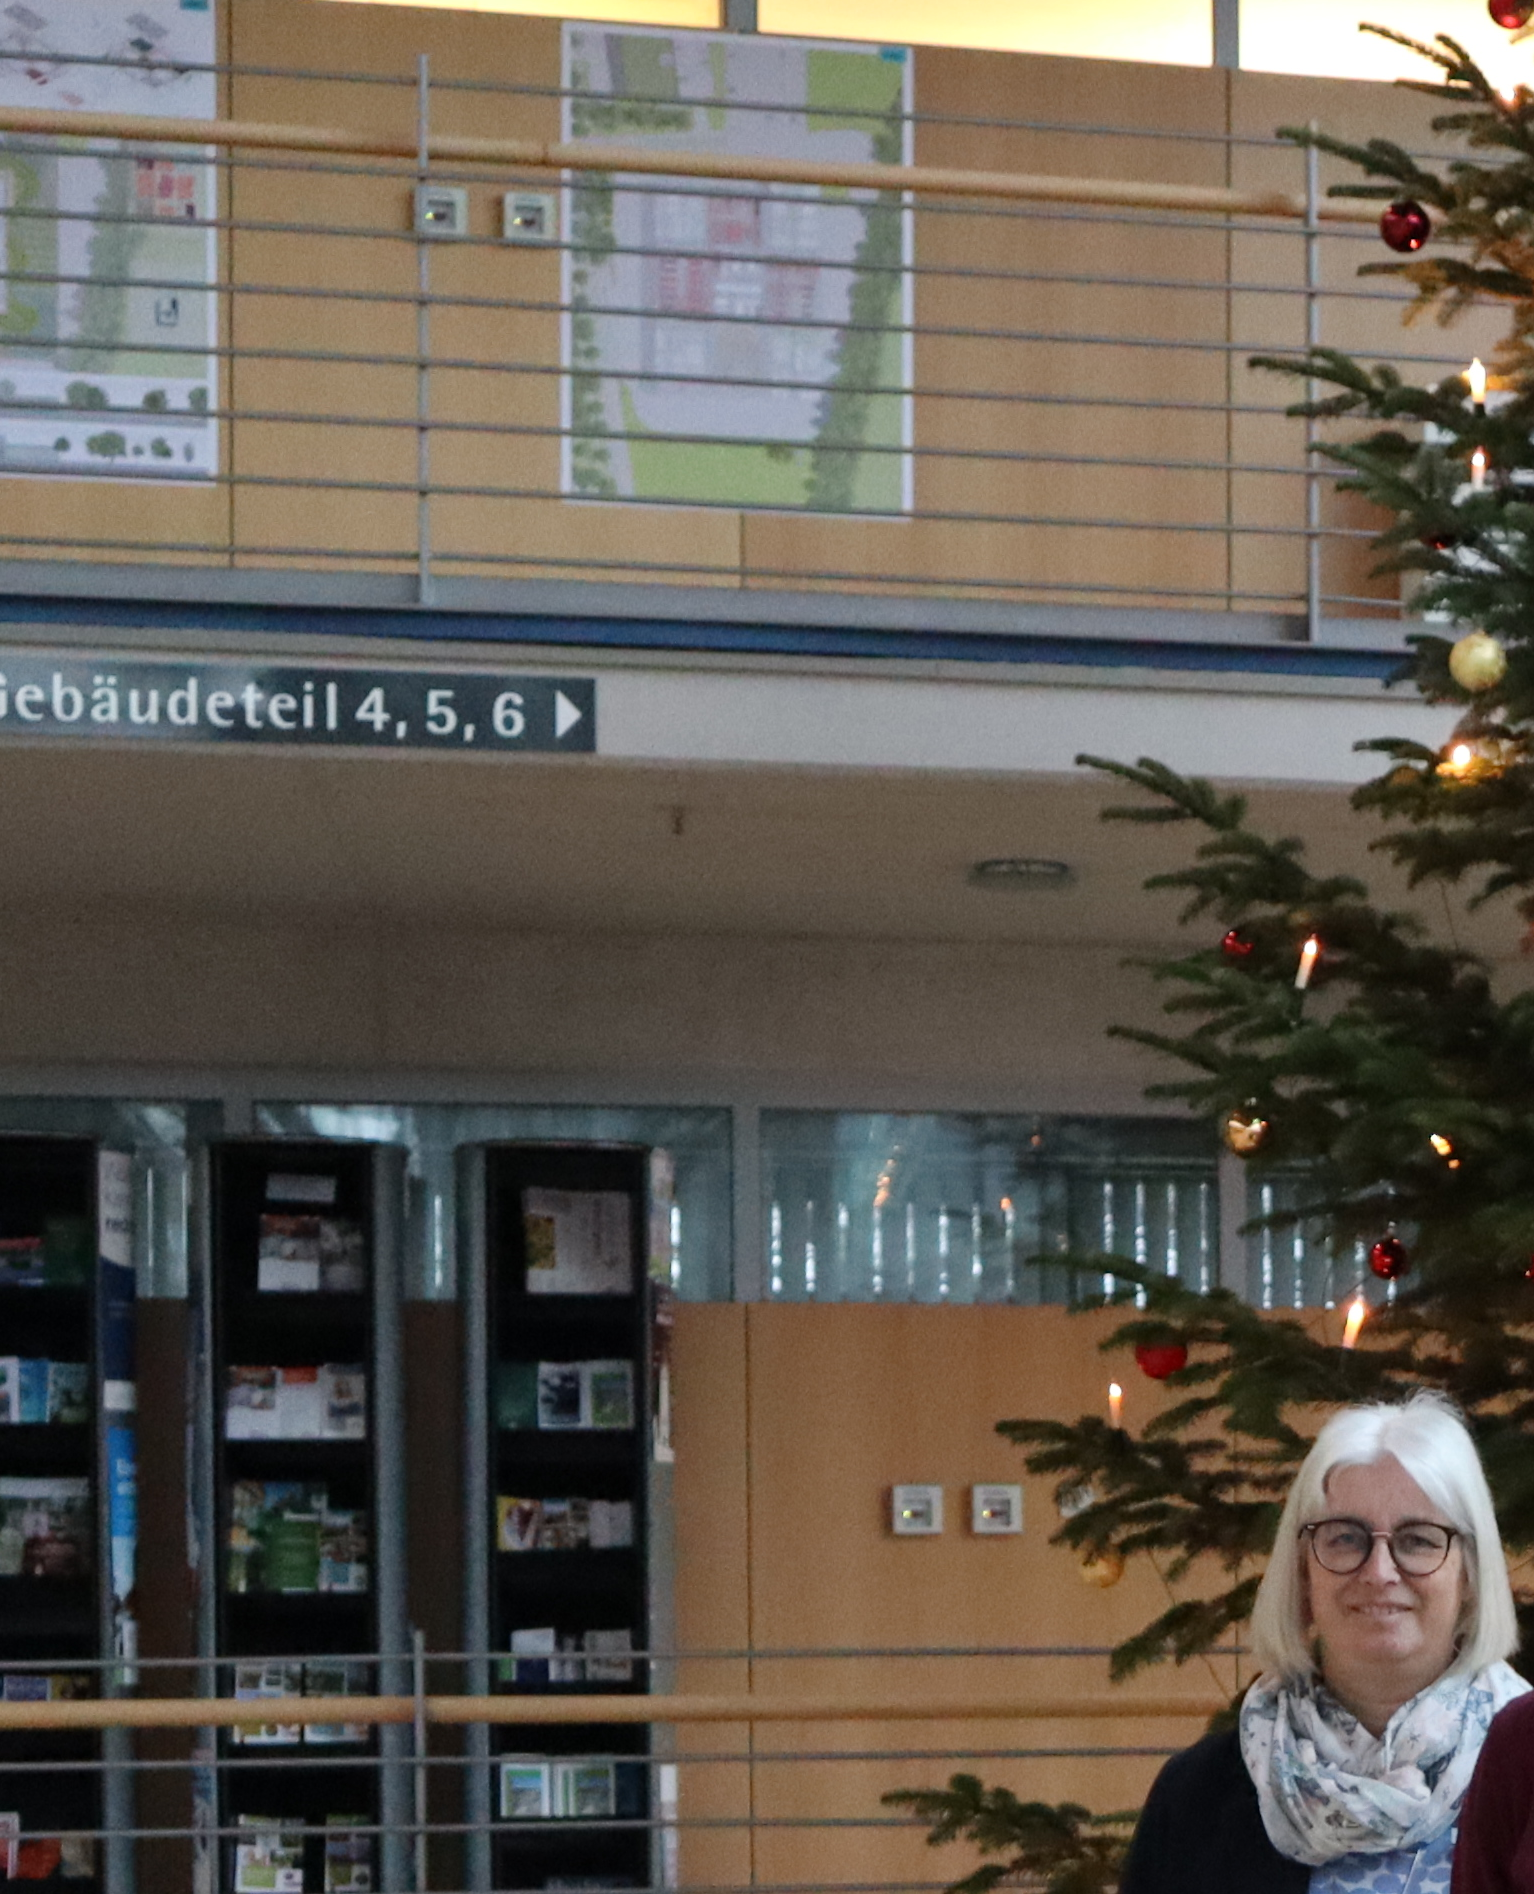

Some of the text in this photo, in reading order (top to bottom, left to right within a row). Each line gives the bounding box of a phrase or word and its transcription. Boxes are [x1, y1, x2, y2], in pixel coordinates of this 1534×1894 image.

[0, 671, 525, 742] ebäudeteil 4, 5, 6
